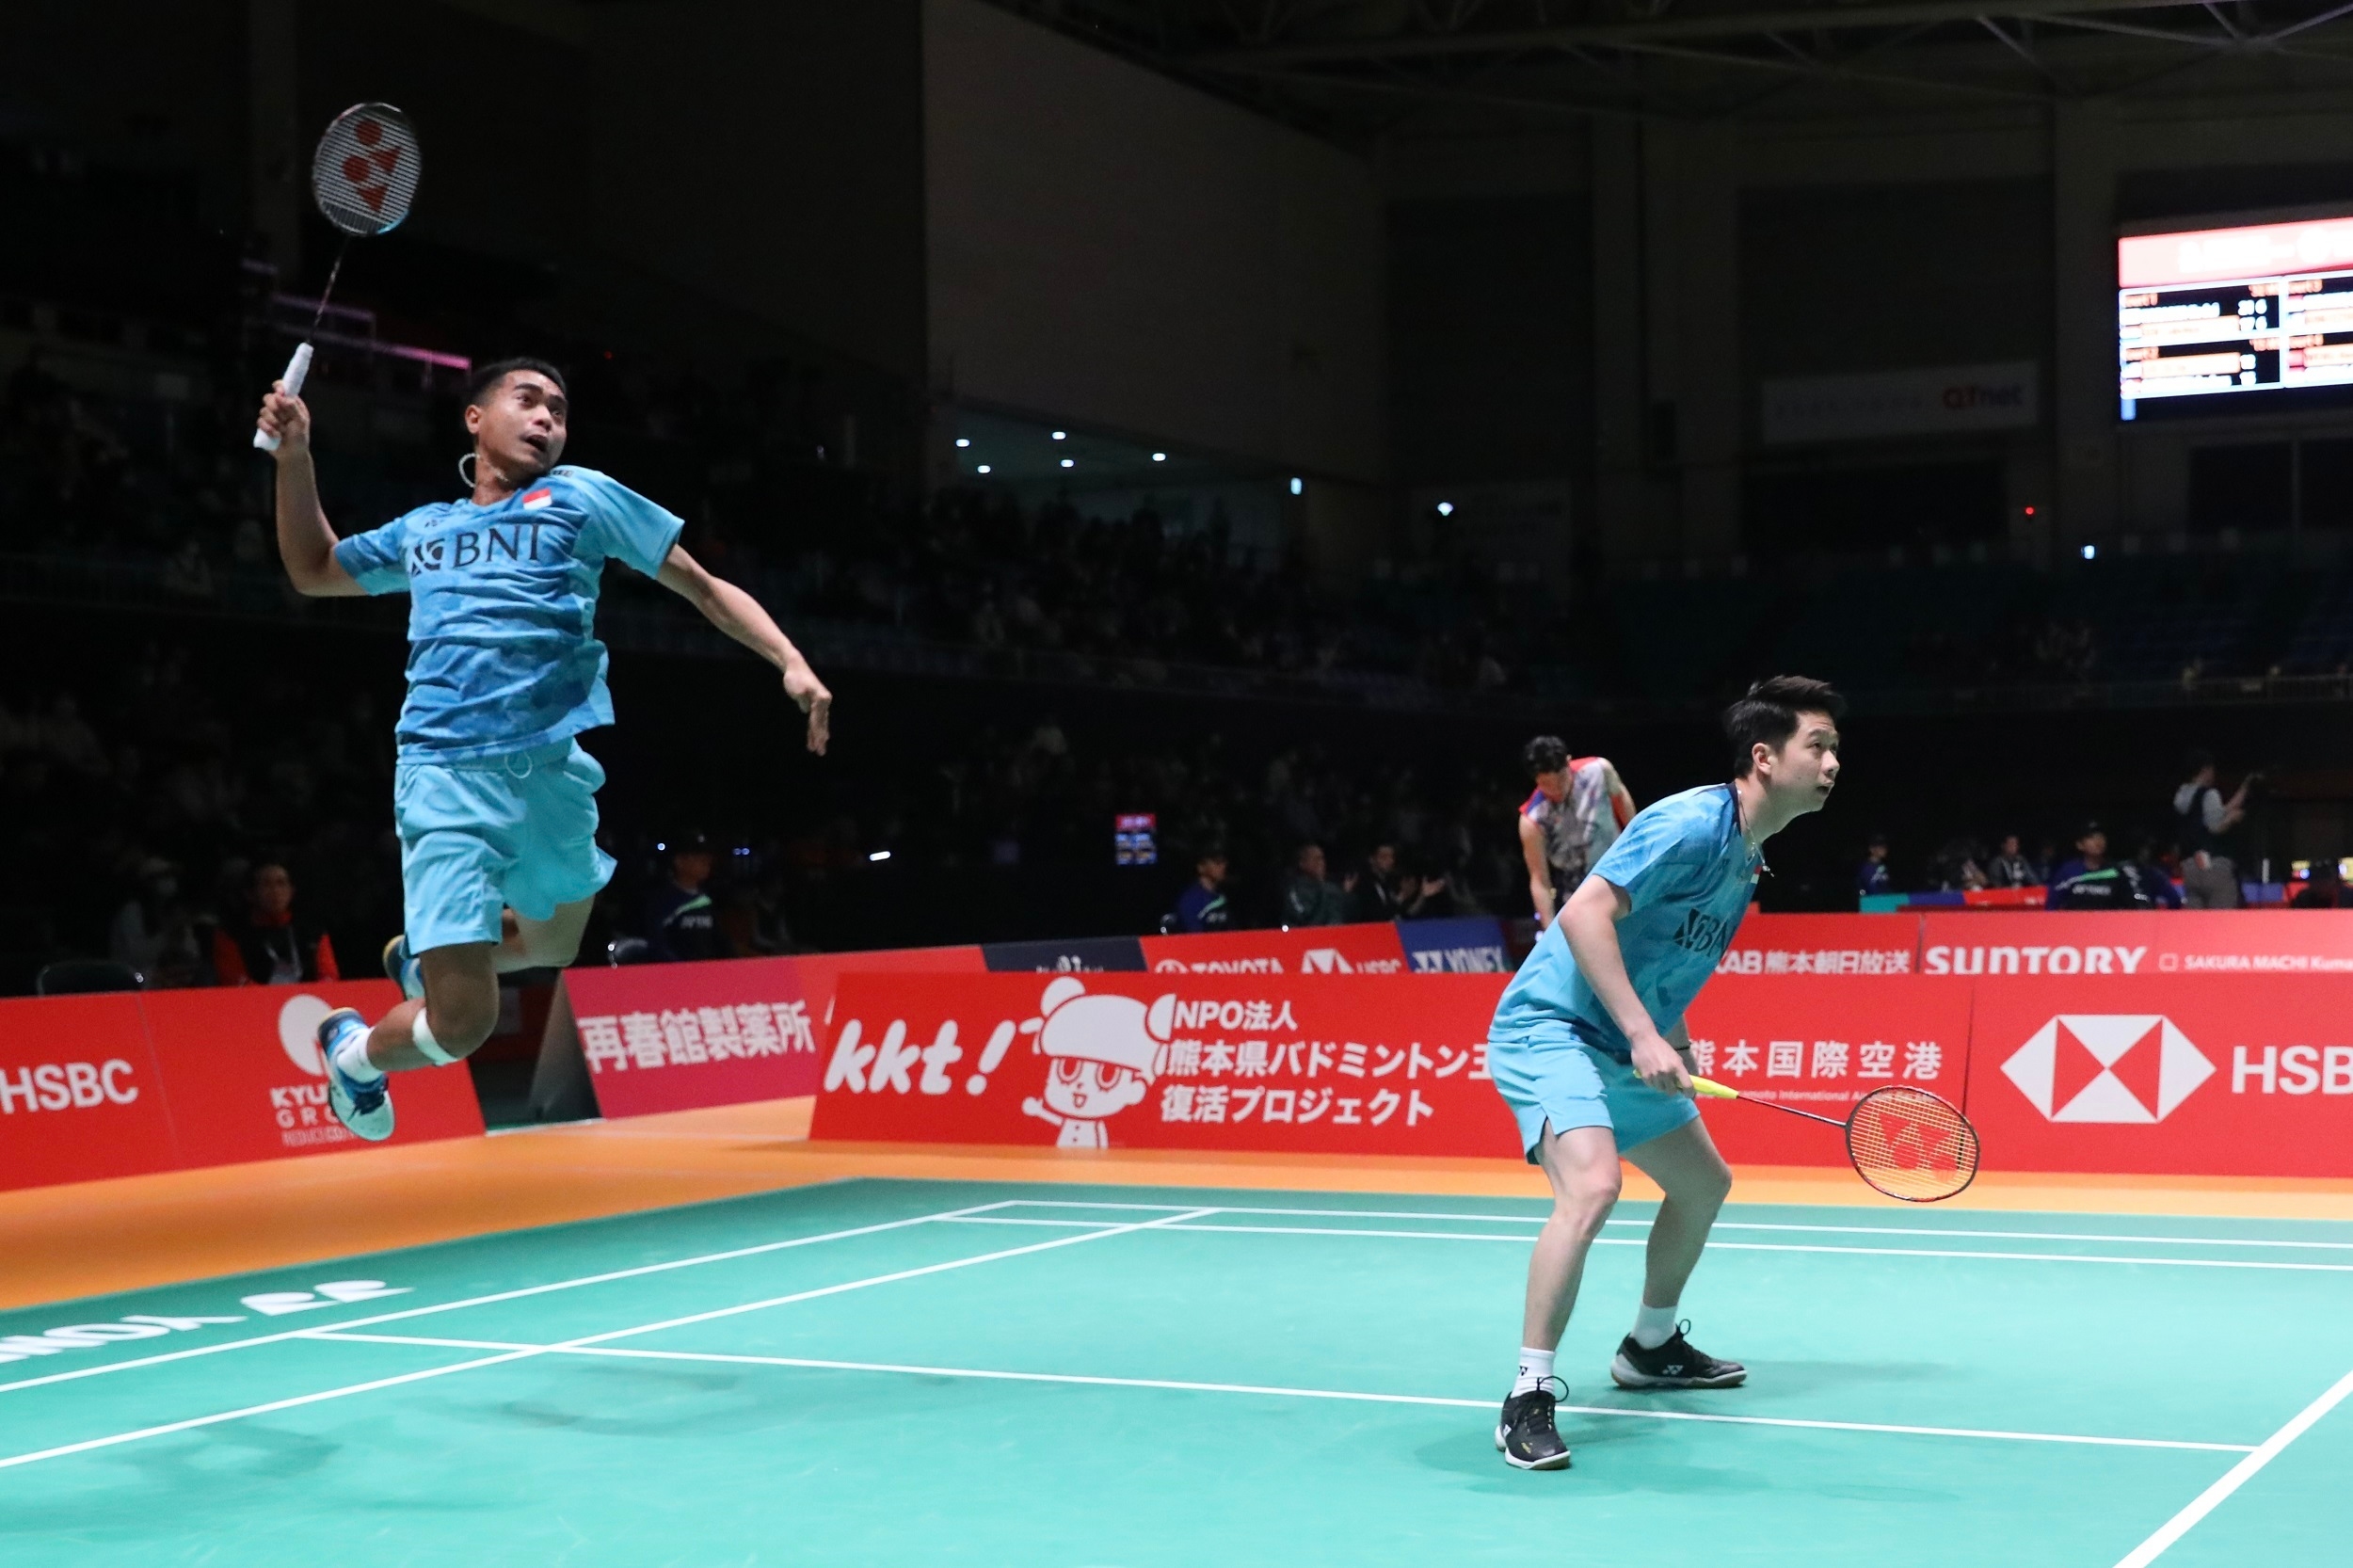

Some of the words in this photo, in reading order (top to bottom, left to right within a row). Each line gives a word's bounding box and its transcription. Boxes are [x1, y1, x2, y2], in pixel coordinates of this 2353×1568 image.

[453, 523, 541, 568] BNI
[1925, 946, 2147, 975] SUNTORY
[2184, 953, 2251, 970] SAKURA
[2252, 953, 2308, 970] MACHI
[2310, 954, 2353, 971] Kuma
[1173, 1000, 1298, 1032] NPO法人
[576, 1000, 816, 1075] 再春館製薬所
[1689, 1039, 1944, 1081] 熊本国際空港
[2232, 1045, 2353, 1095] HSB
[0, 1058, 138, 1114] HSBC
[270, 1084, 331, 1109] KYU
[1161, 1083, 1434, 1128] 復活プロジェクト
[1778, 1090, 1850, 1102] International
